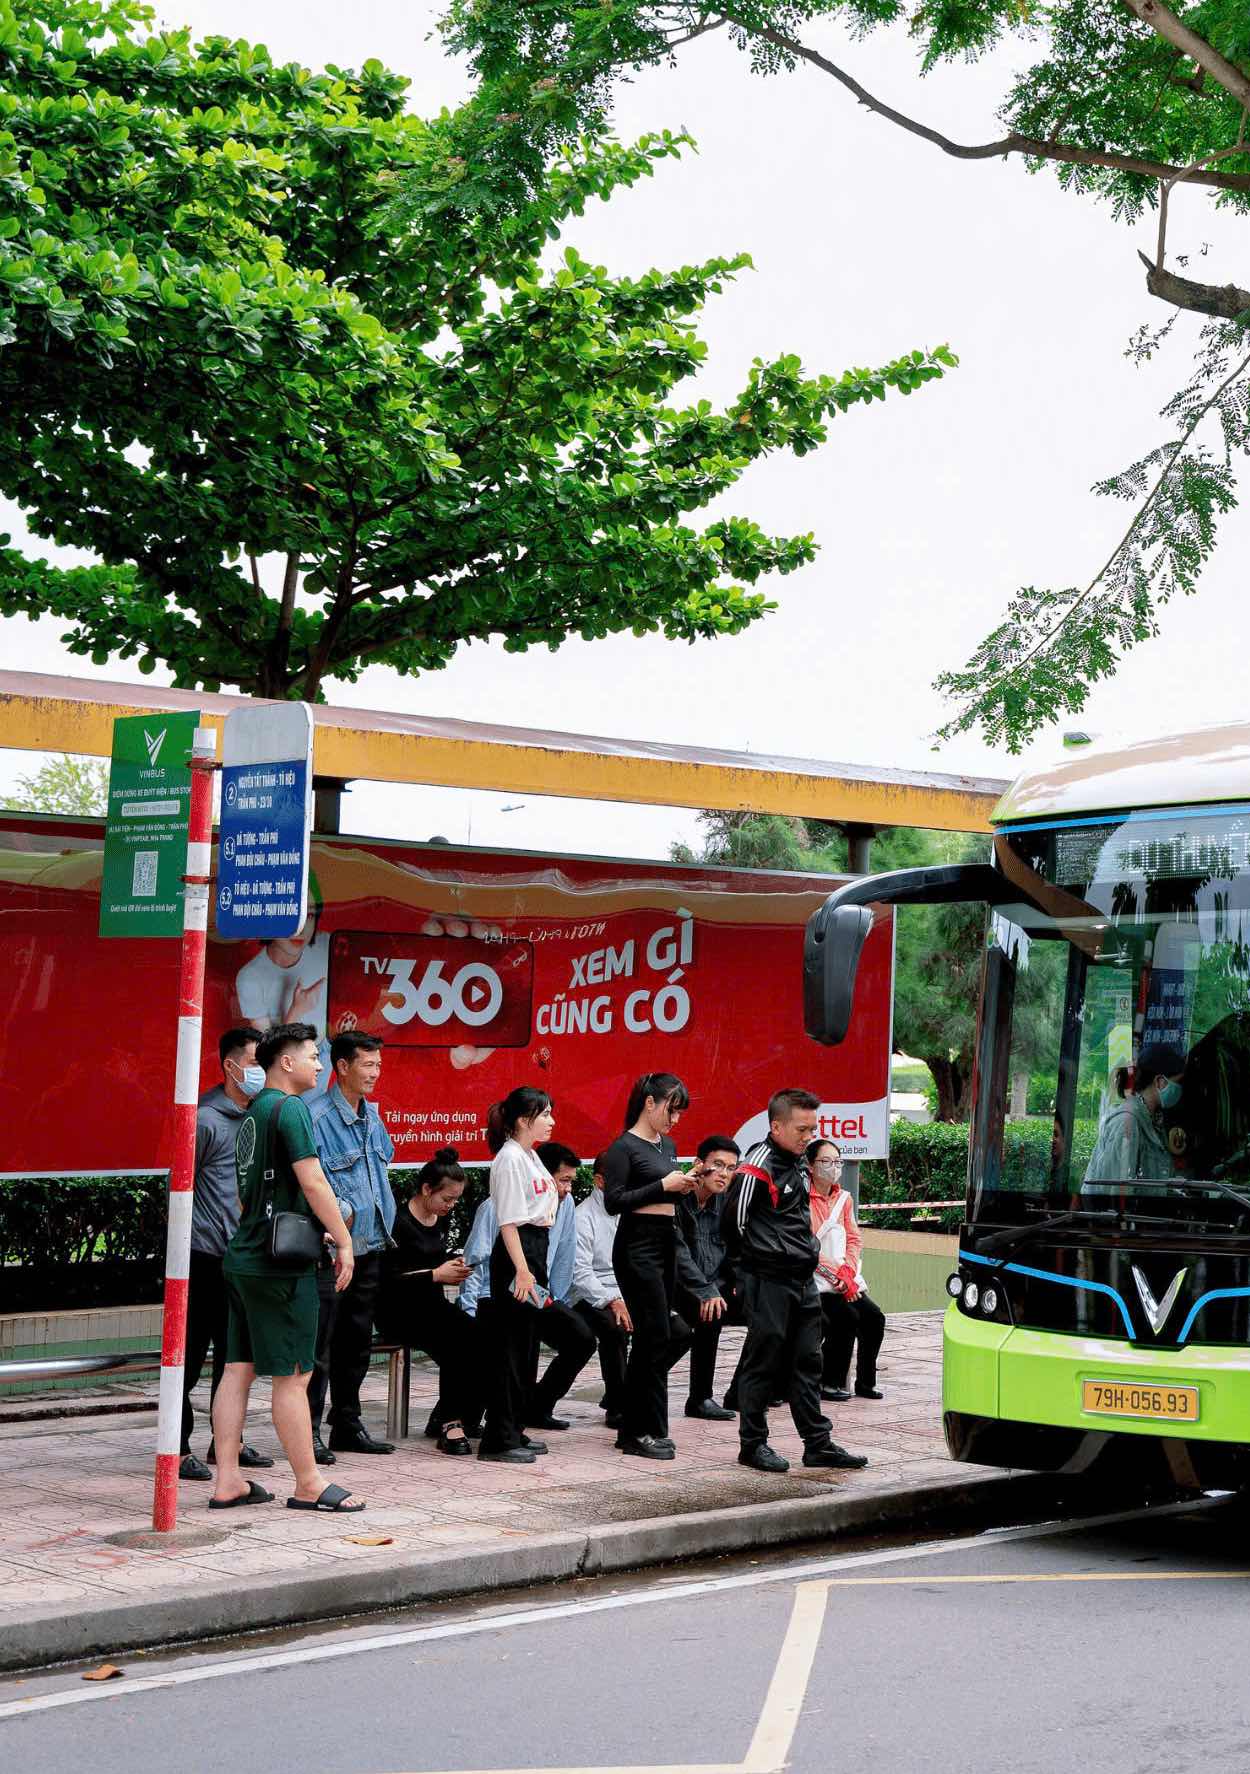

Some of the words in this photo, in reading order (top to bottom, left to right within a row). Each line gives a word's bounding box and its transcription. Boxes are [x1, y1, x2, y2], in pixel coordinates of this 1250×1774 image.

[140, 769, 165, 778] VINBUS
[568, 940, 634, 988] XEM
[646, 906, 694, 970] GÌ
[536, 992, 613, 1034] CŨNG
[624, 967, 690, 1033] CÓ
[385, 1111, 400, 1123] Tải
[404, 1113, 428, 1125] ngay
[431, 1111, 449, 1125] ứng
[452, 1111, 477, 1125] dụng
[389, 1129, 417, 1145] ruyền
[420, 1130, 442, 1142] hình
[445, 1130, 463, 1144] giải
[1094, 1388, 1188, 1413] 79H-056.93
